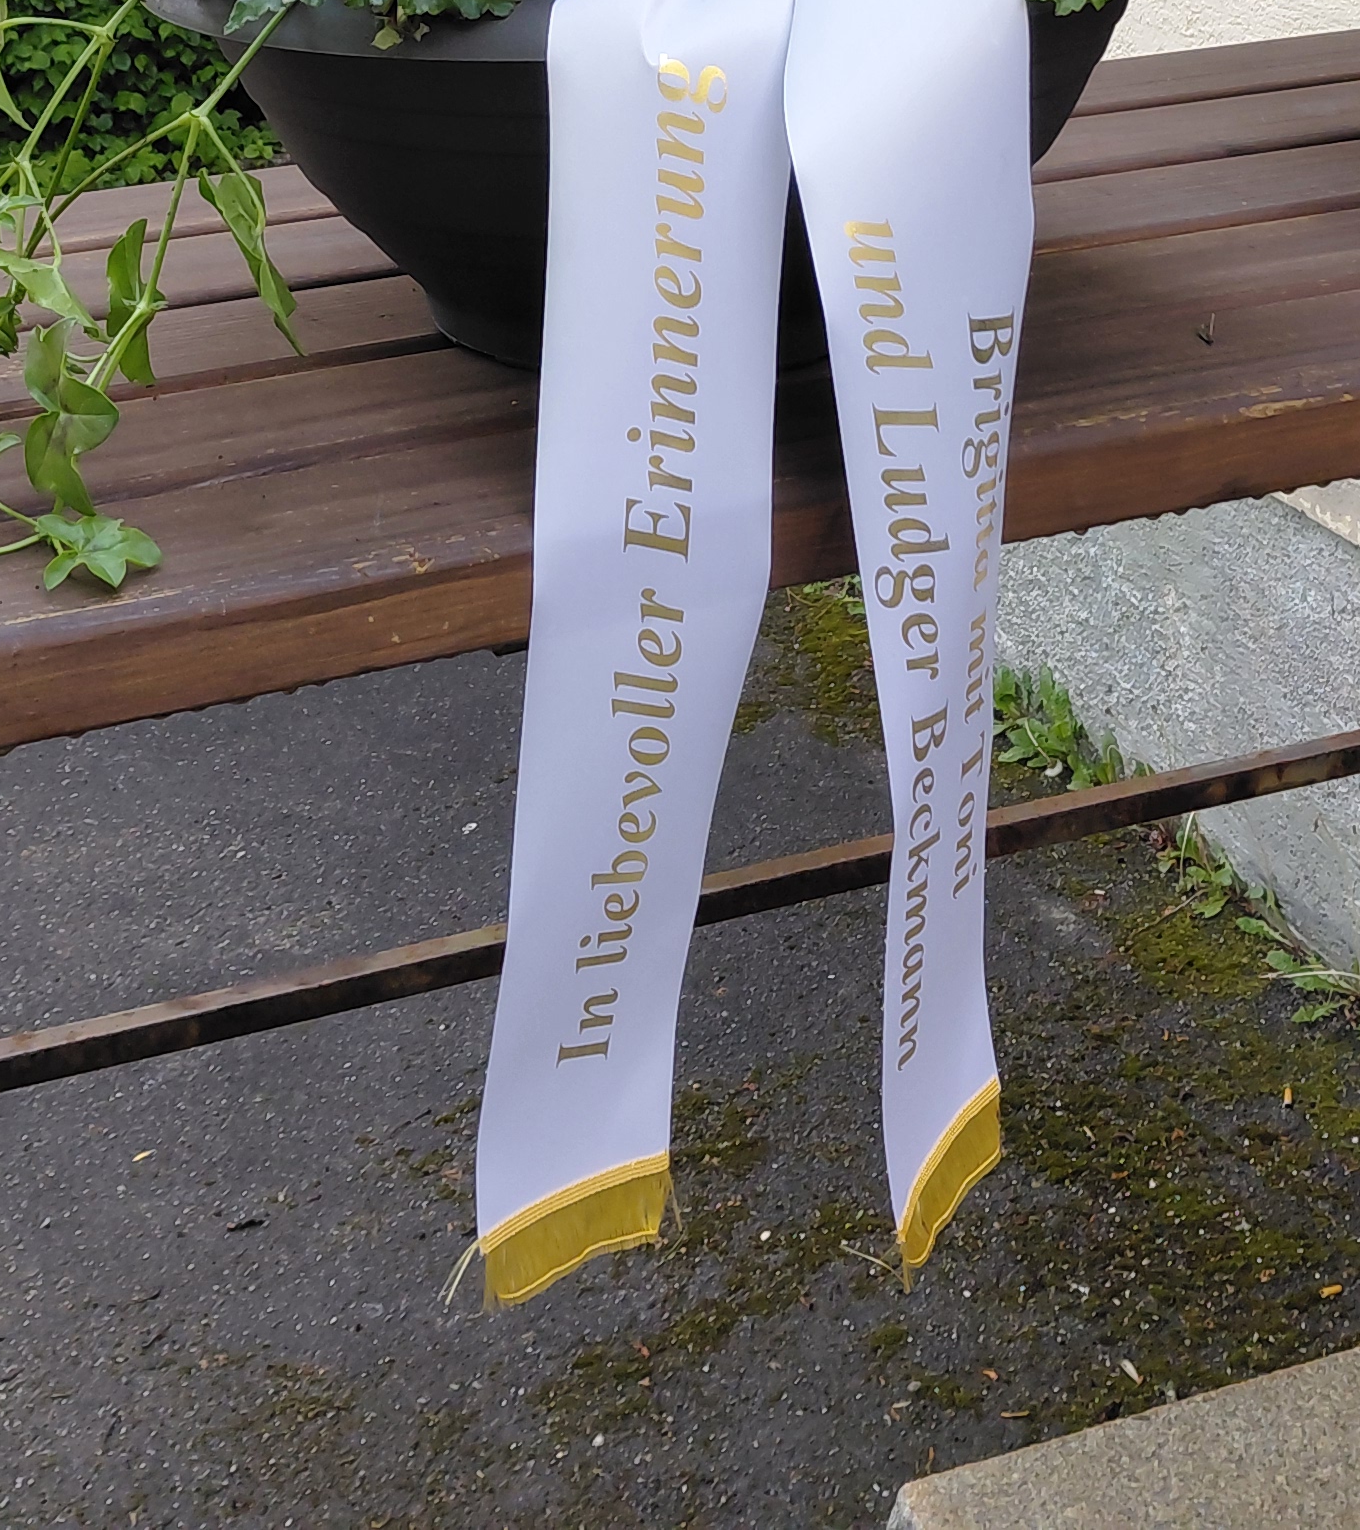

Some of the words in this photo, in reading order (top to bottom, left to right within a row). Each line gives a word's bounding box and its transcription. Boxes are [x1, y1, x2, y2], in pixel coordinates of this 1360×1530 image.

[621, 52, 728, 564] Erinnerung
[844, 217, 935, 375] und
[870, 401, 951, 682] Ludger
[961, 311, 1016, 593] Brigitta
[575, 587, 686, 974] liebevoller
[963, 606, 992, 724] mit
[896, 698, 949, 1072] Beckmann
[952, 730, 984, 901] Toni
[556, 987, 620, 1070] In
